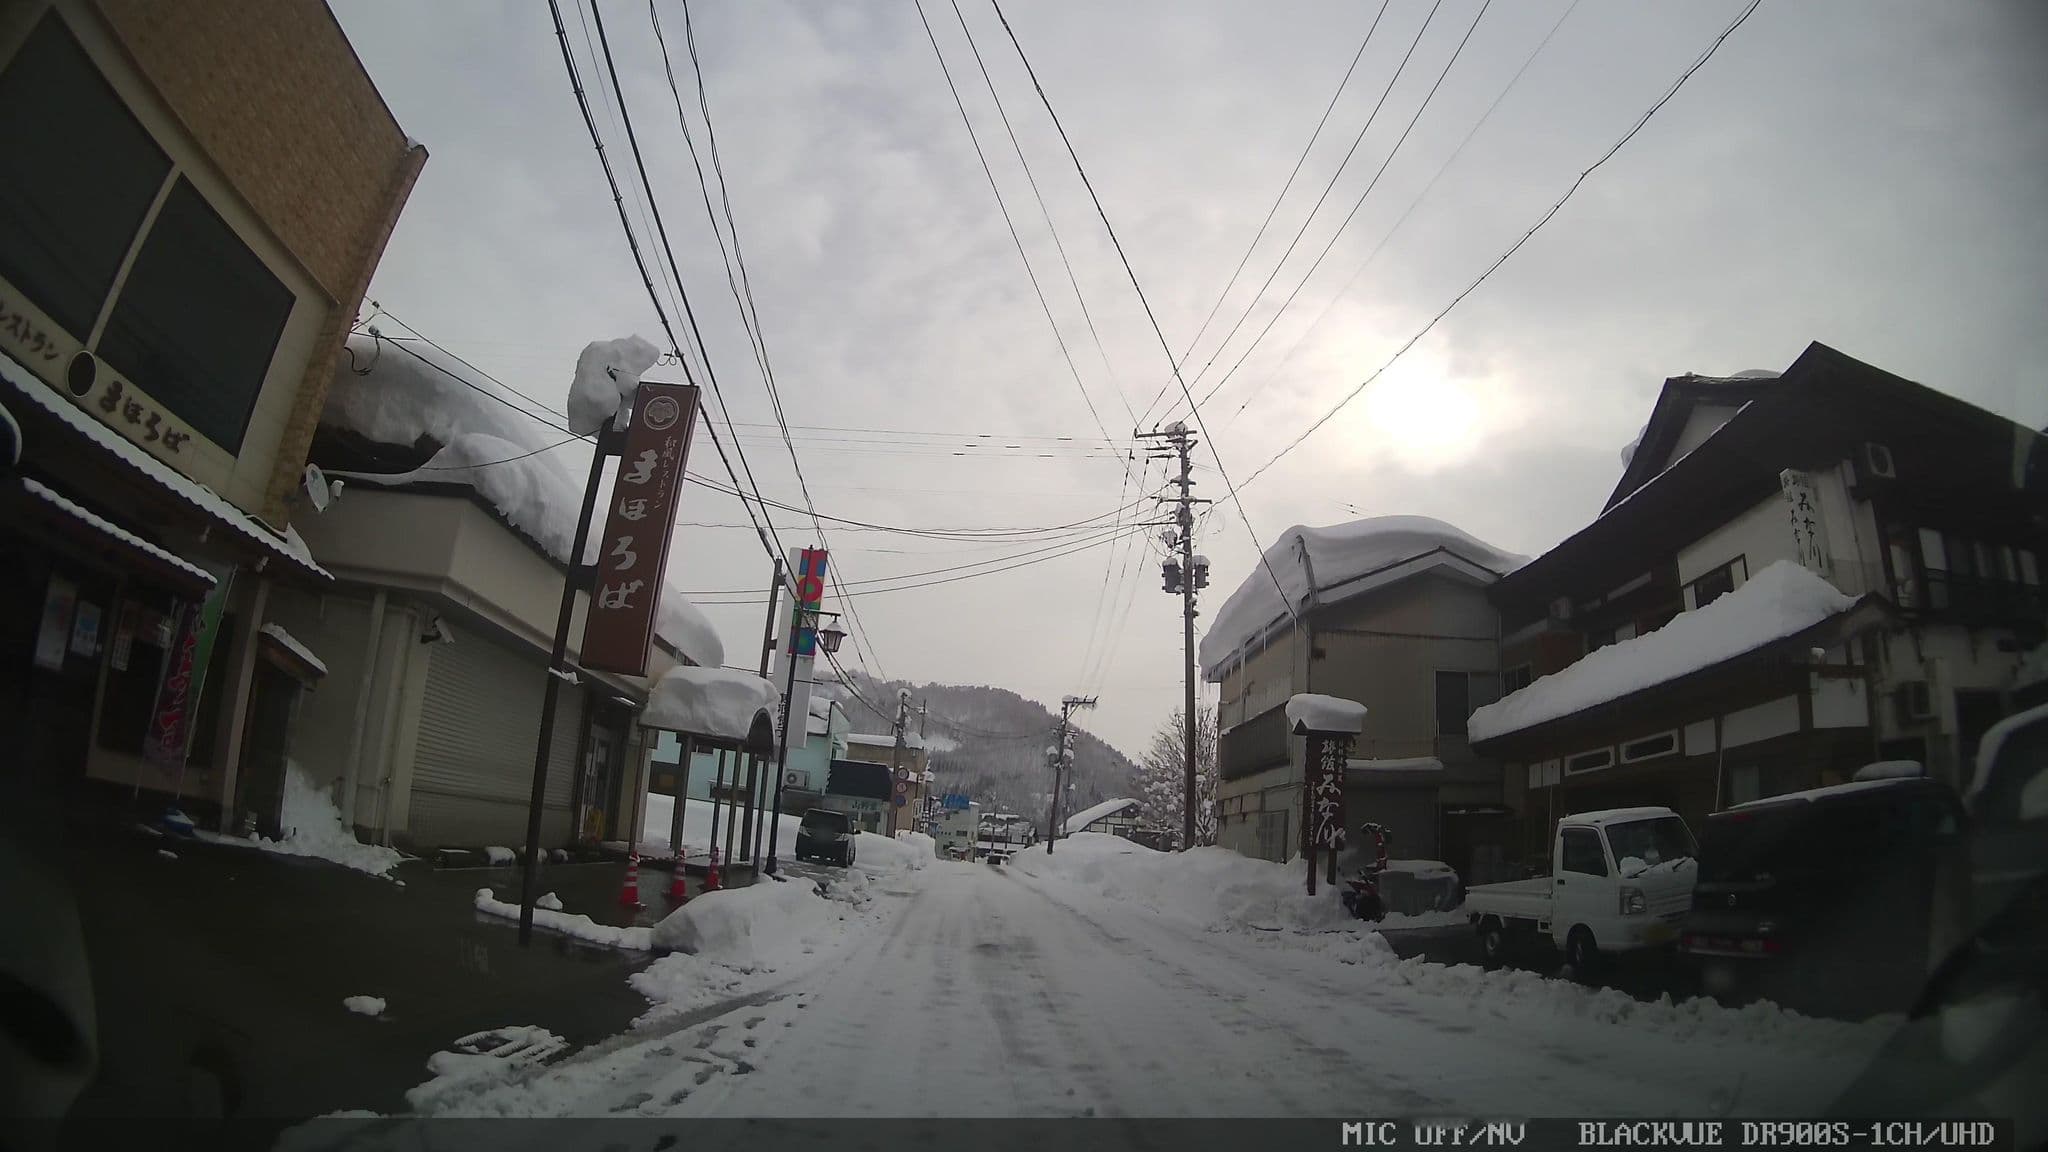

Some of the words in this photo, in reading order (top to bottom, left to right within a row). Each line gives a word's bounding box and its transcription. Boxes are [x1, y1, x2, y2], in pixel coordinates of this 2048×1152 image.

[97, 380, 191, 454] まほろば
[654, 435, 677, 509] 和風レストラン
[598, 449, 658, 609] まほろば
